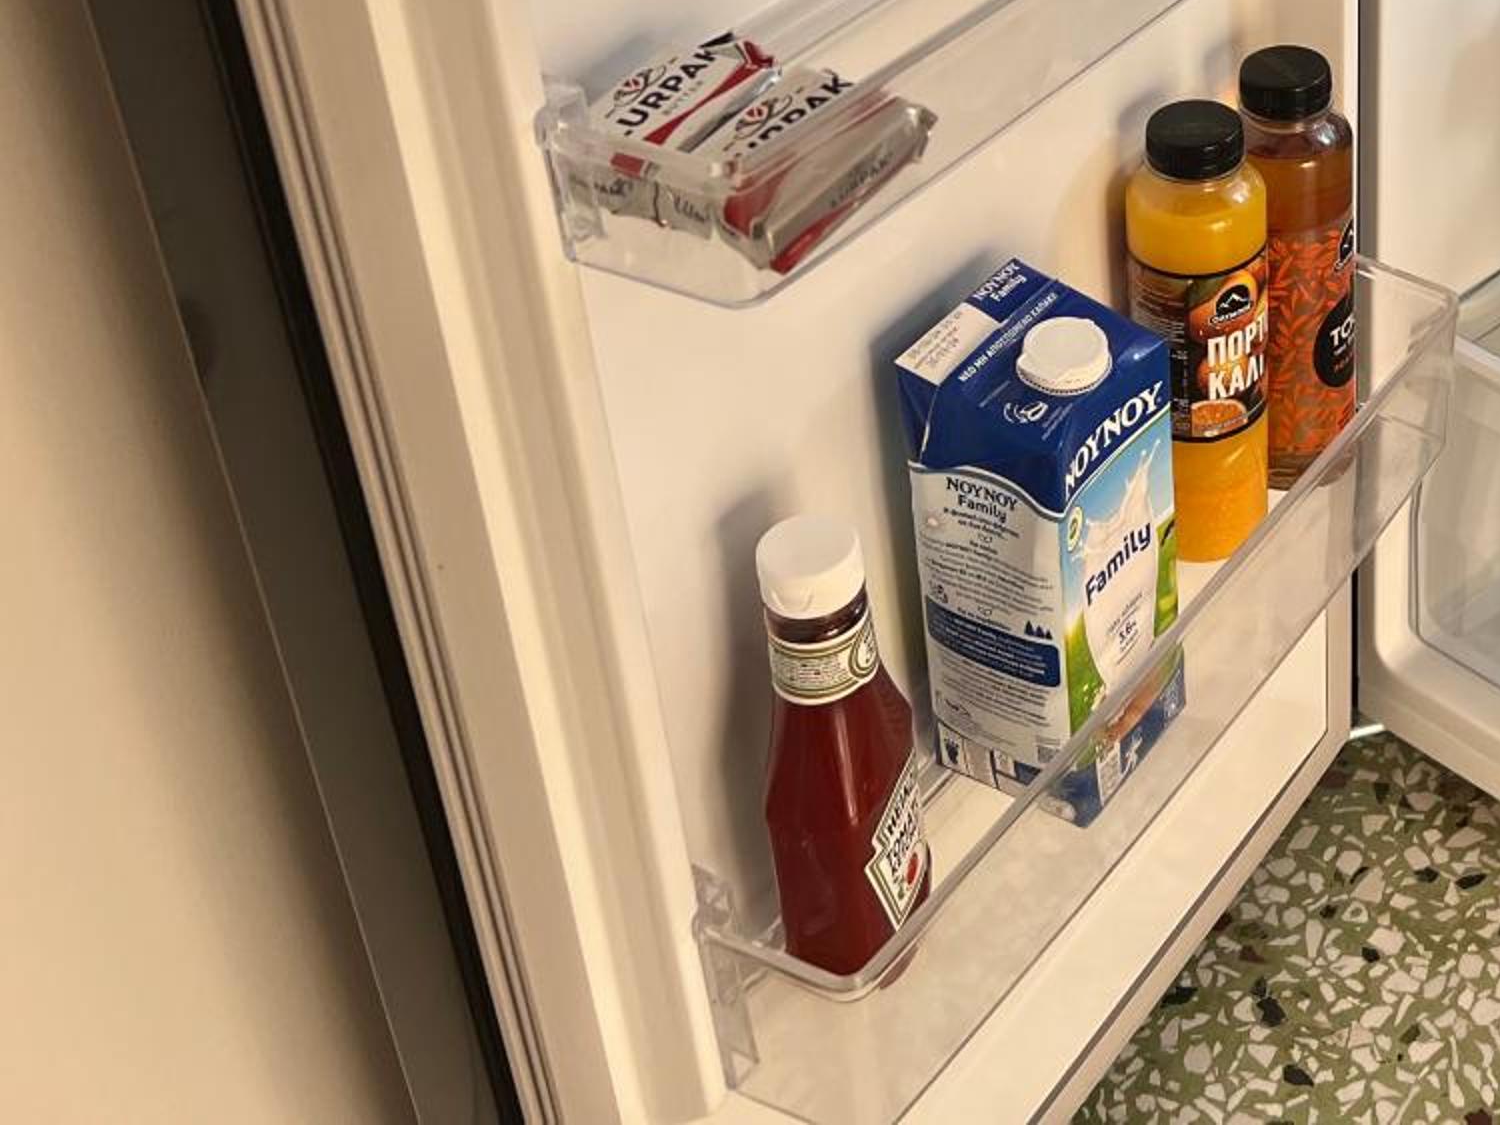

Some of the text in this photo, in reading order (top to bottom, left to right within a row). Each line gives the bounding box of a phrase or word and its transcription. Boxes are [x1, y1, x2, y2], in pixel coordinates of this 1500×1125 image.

[617, 49, 718, 137] URPAK
[945, 475, 1018, 512] NOYNOY
[957, 494, 1007, 525] Family
[1085, 522, 1152, 607] Family
